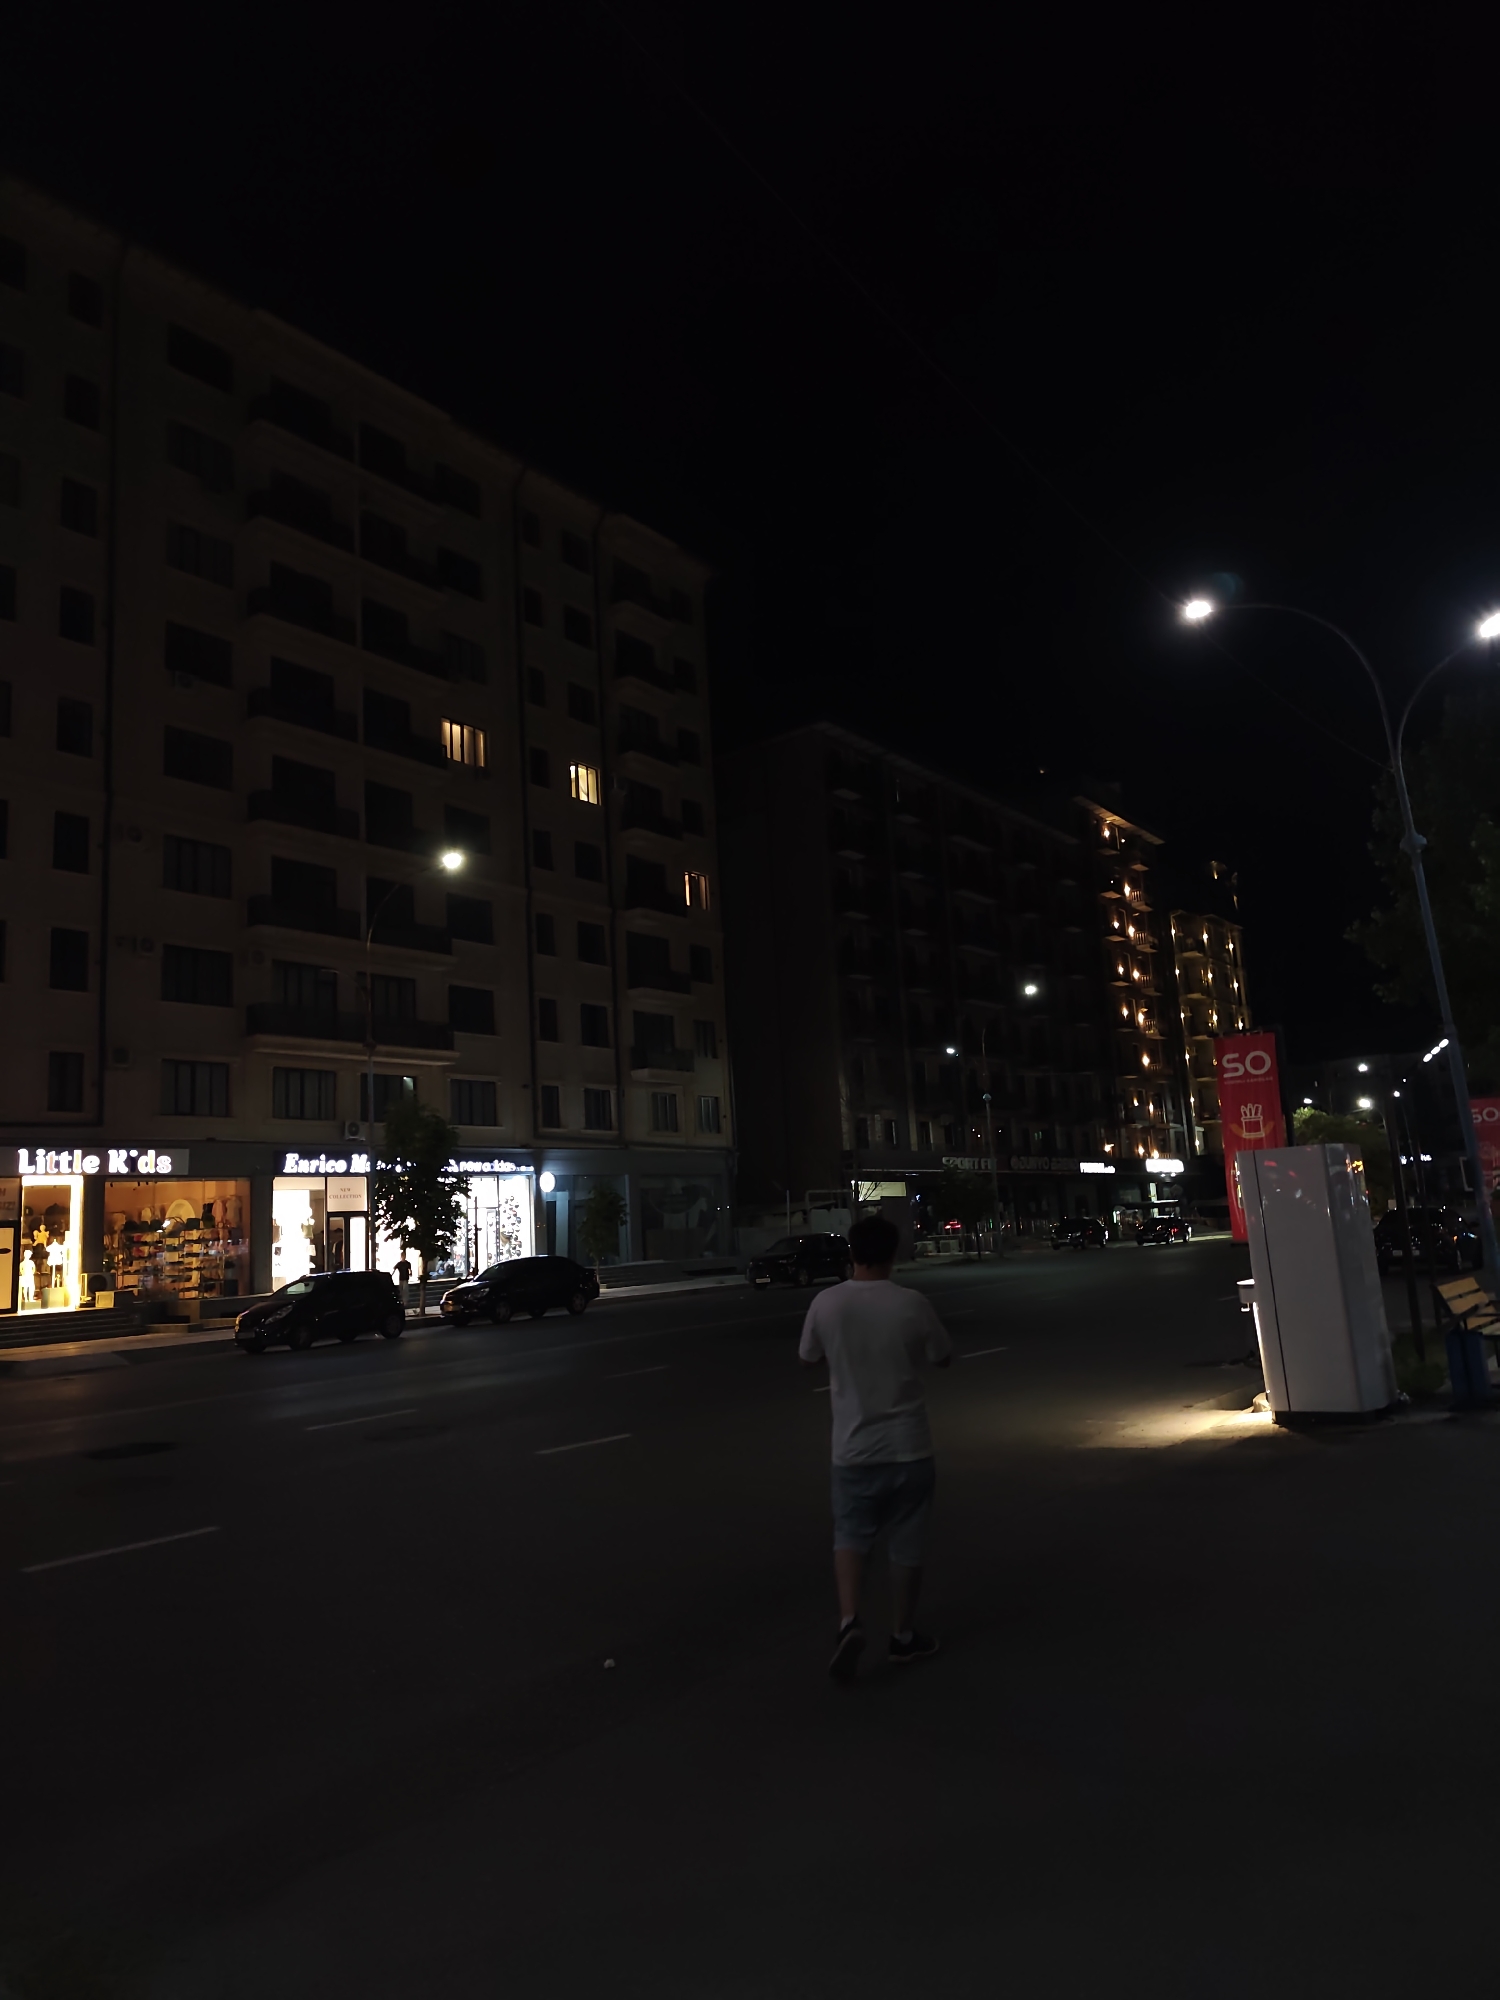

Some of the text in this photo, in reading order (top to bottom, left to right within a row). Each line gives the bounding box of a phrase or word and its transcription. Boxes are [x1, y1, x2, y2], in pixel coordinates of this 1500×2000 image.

[1221, 1050, 1272, 1079] SO
[17, 1148, 173, 1175] Little Kids
[283, 1153, 348, 1174] Enrico
